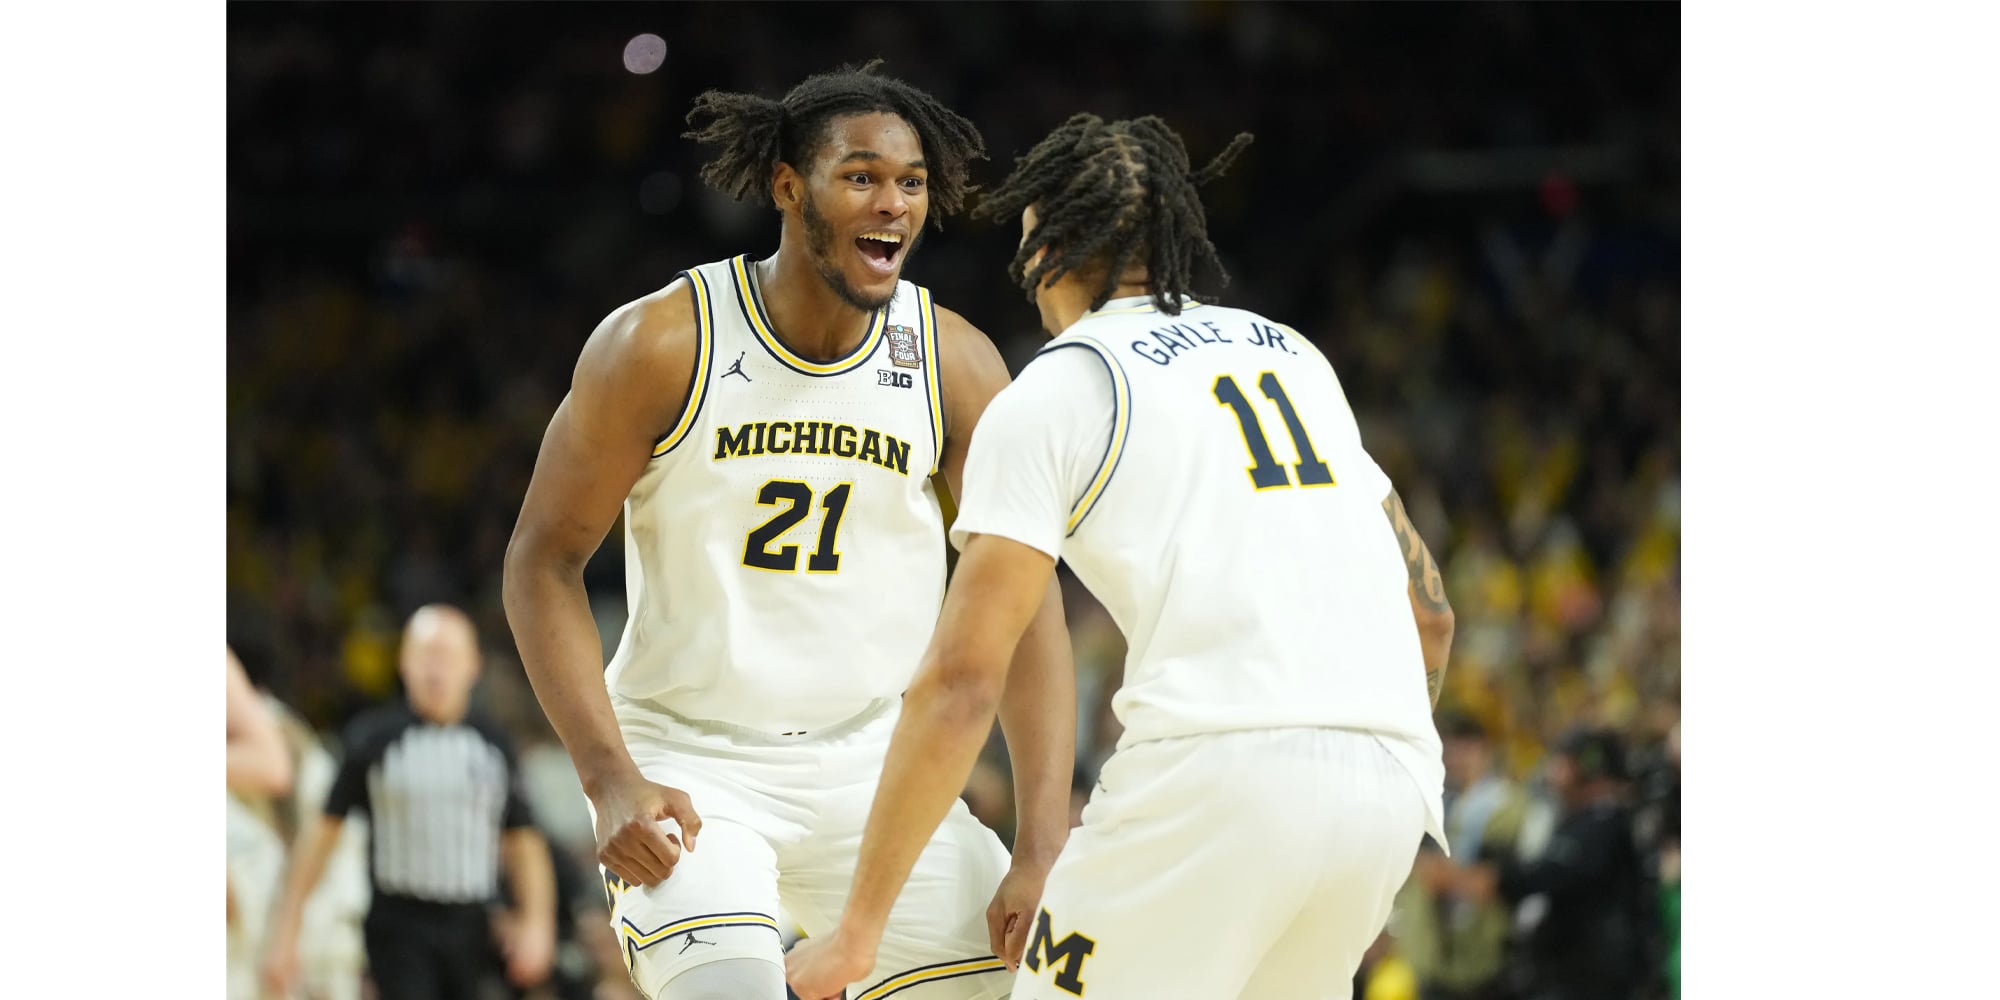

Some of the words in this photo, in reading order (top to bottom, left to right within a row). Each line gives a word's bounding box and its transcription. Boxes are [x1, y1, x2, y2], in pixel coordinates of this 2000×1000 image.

[890, 333, 912, 343] FINAL
[894, 350, 916, 360] FOUR
[1131, 321, 1233, 366] GAYLE
[1247, 322, 1298, 356] JR.
[712, 421, 911, 477] MICHIGAN
[1210, 369, 1337, 492] 11
[740, 477, 854, 574] 21
[1025, 905, 1098, 998] M
